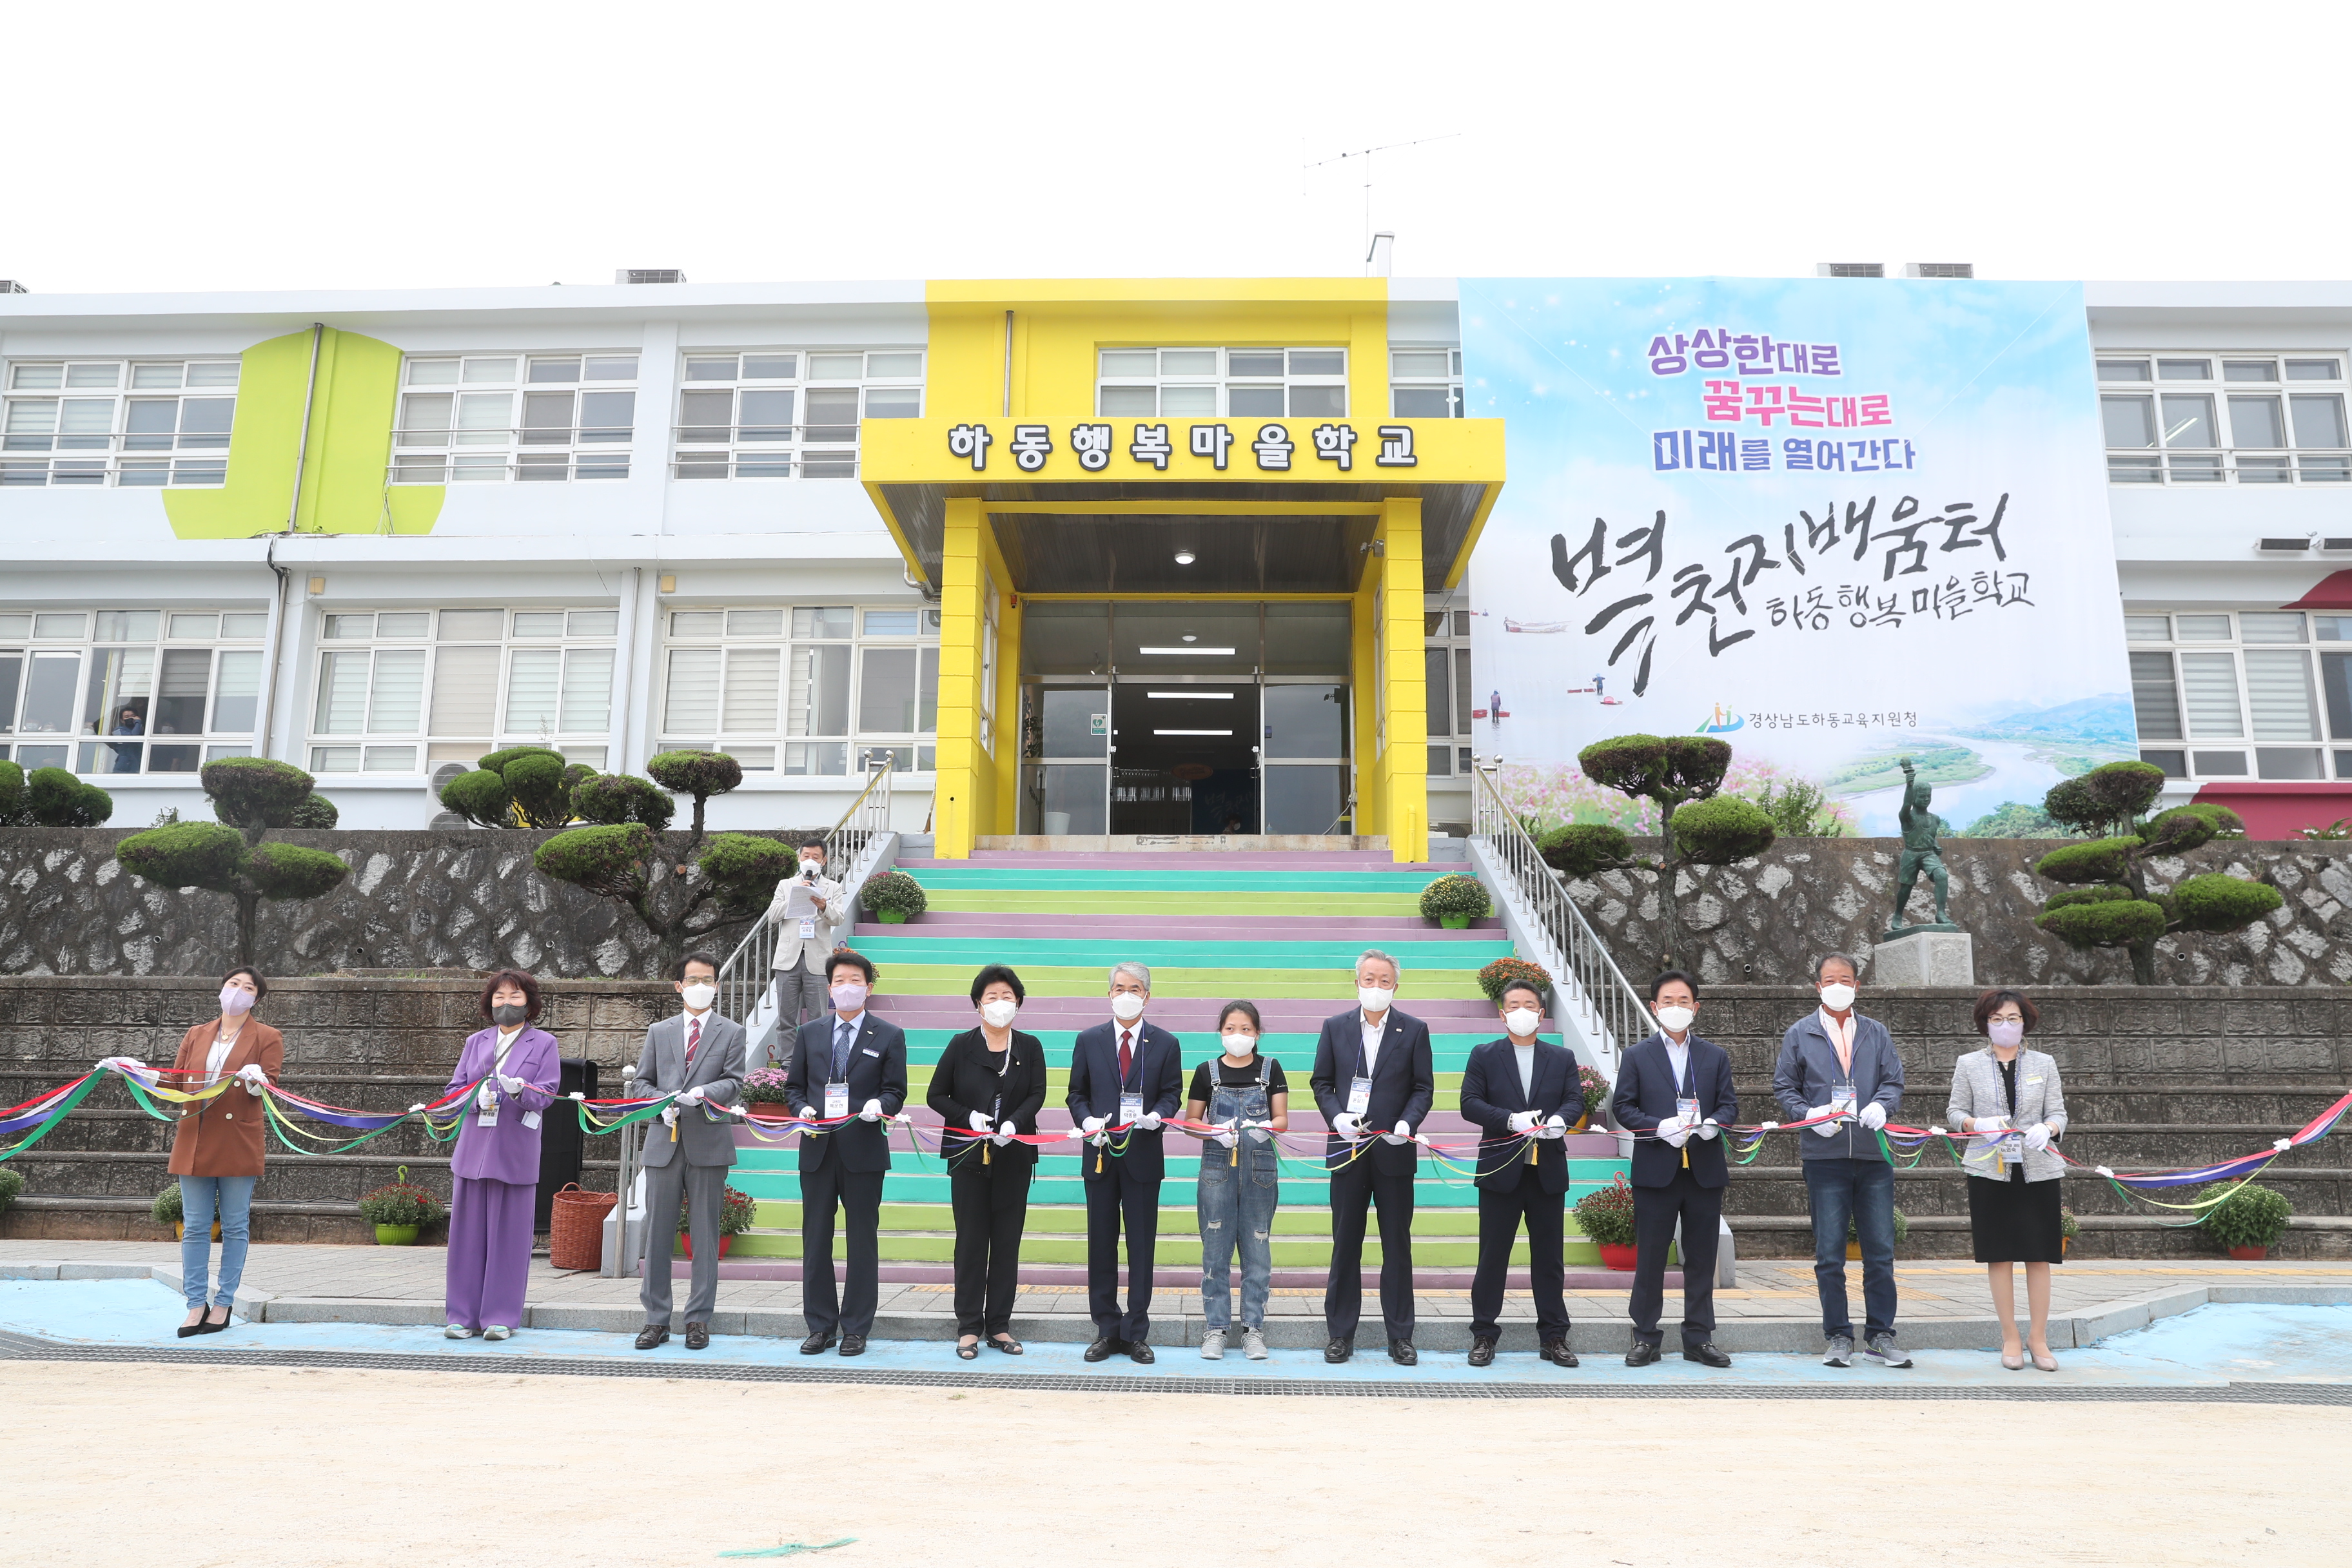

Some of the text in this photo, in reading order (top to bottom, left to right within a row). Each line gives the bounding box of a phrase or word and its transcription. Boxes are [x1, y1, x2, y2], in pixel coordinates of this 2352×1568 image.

[1649, 328, 1841, 376] 상상한대로
[1703, 379, 1892, 428] 꿈꾸는대로
[947, 423, 1418, 472] 하동행복마을학교
[1654, 429, 1916, 472] 미래를 열어간다
[1749, 711, 1917, 729] 경상남도하동교육지원청
